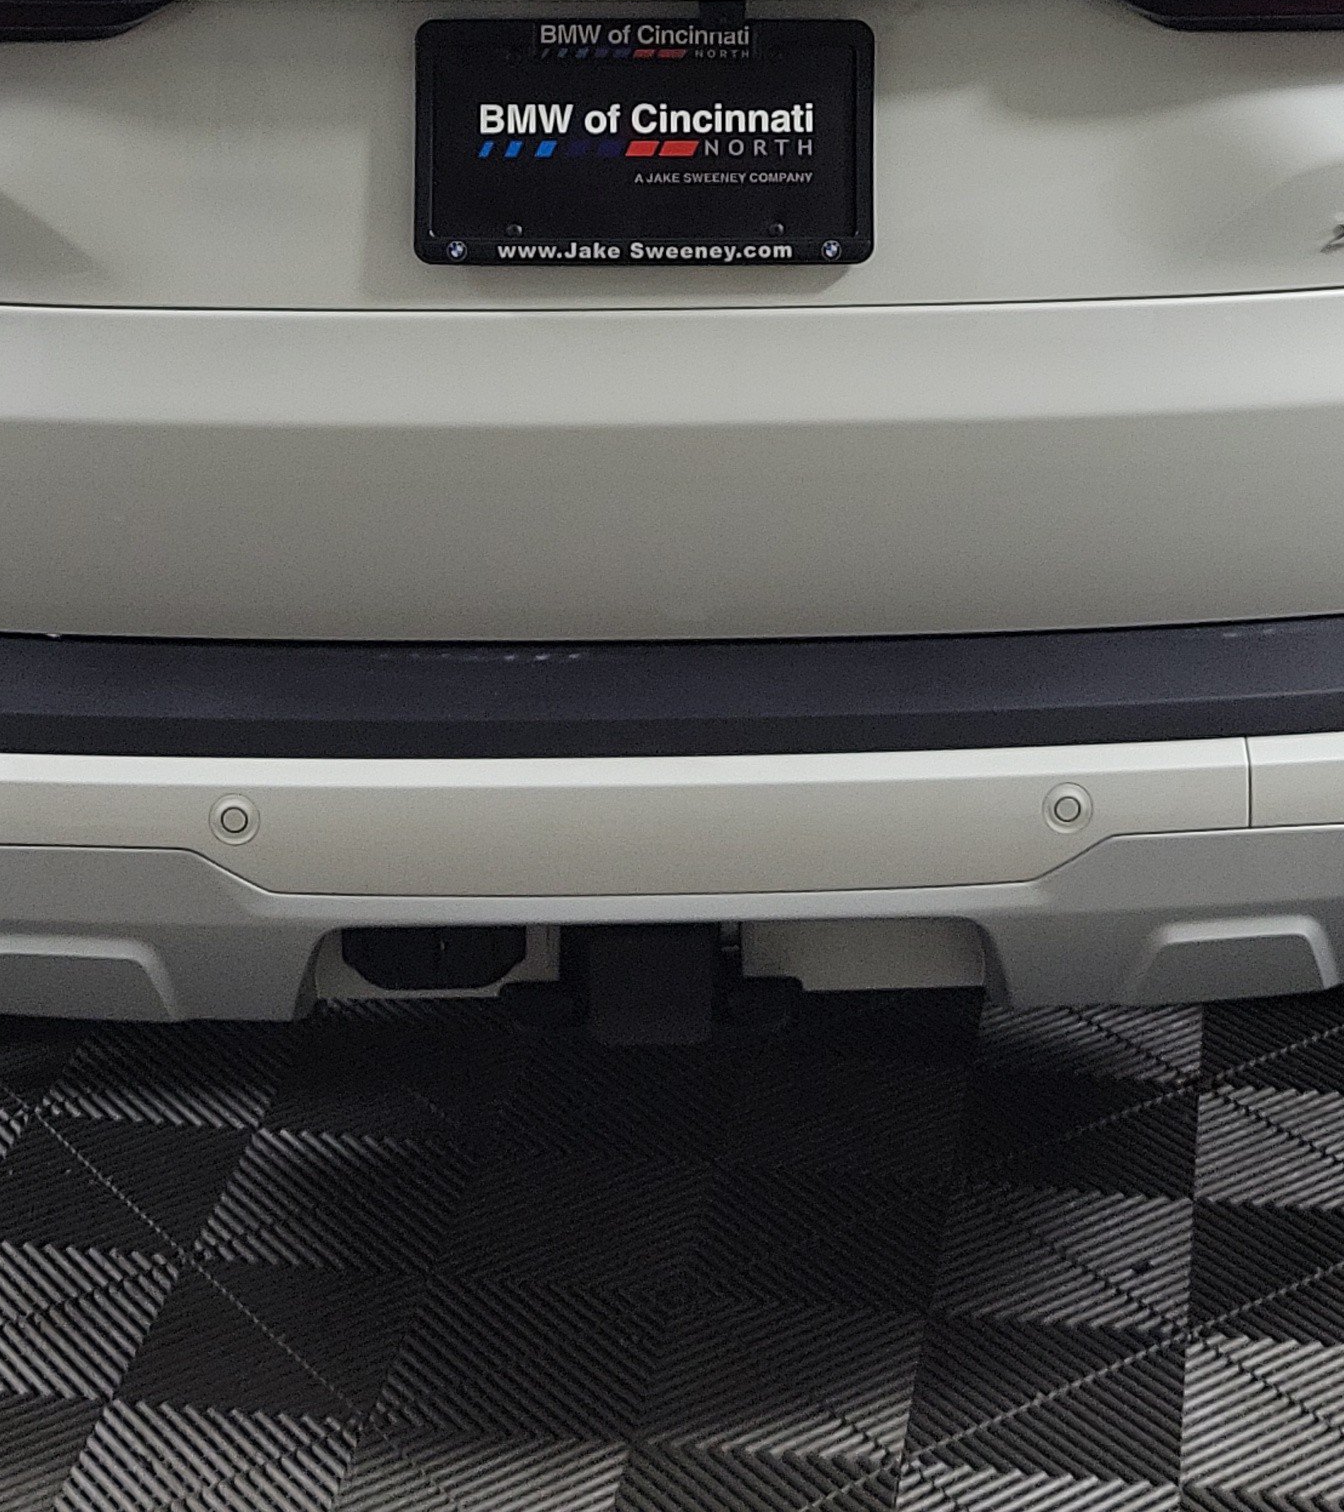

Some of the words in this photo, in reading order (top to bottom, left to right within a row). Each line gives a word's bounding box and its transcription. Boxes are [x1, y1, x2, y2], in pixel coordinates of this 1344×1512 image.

[540, 24, 602, 45] BMW
[608, 24, 632, 45] of
[636, 24, 750, 45] Cincinnati
[694, 48, 750, 59] NORTH
[479, 103, 574, 135] BMW
[583, 102, 621, 135] of
[630, 103, 814, 135] Cincinnati
[704, 139, 813, 157] NORTH
[634, 172, 644, 184] A
[646, 172, 681, 184] JAKE
[683, 172, 747, 184] SWEENEY
[749, 172, 814, 184] COMPANY
[497, 242, 621, 260] www.Jake
[630, 242, 793, 263] Sweeney.com
